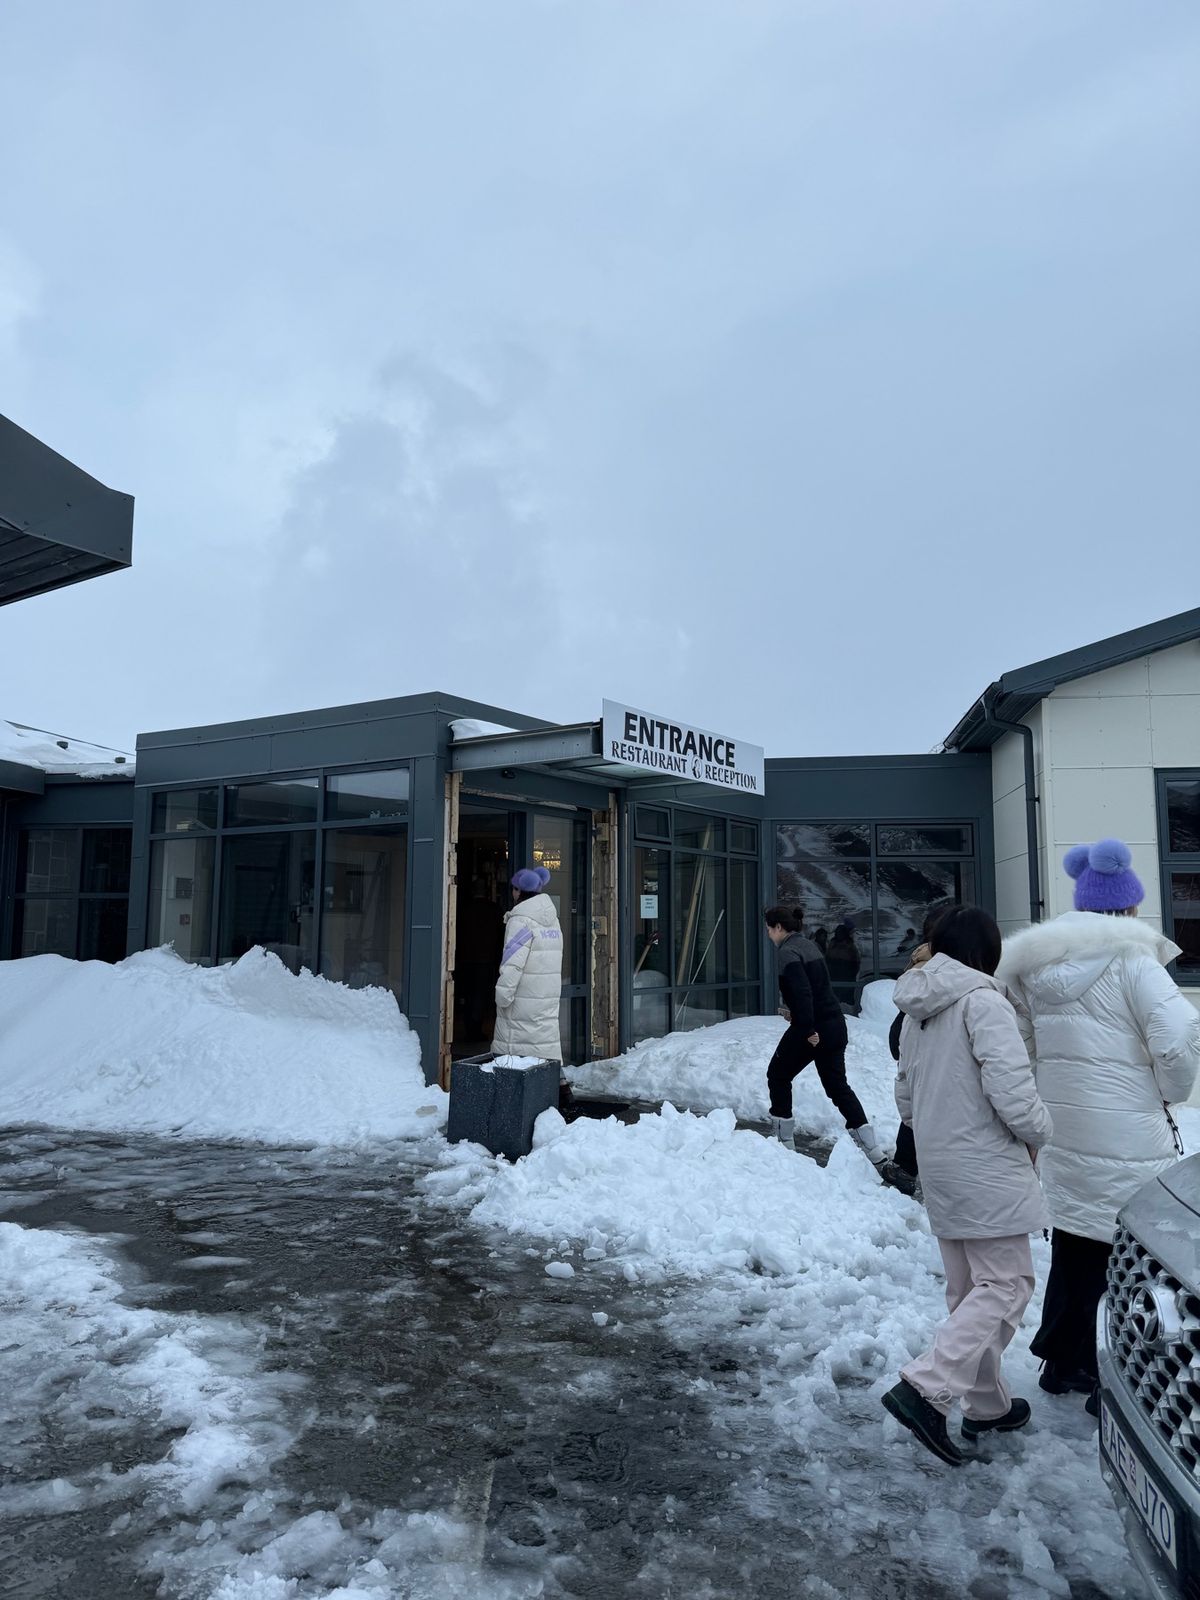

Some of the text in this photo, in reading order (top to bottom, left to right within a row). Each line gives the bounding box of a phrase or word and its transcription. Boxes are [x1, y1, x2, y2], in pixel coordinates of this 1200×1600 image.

[611, 740, 757, 790] RESTAURANT RECEPTION
[624, 711, 735, 768] ENTRANCE
[1109, 1421, 1128, 1480] AE
[1139, 1473, 1171, 1549] J70
